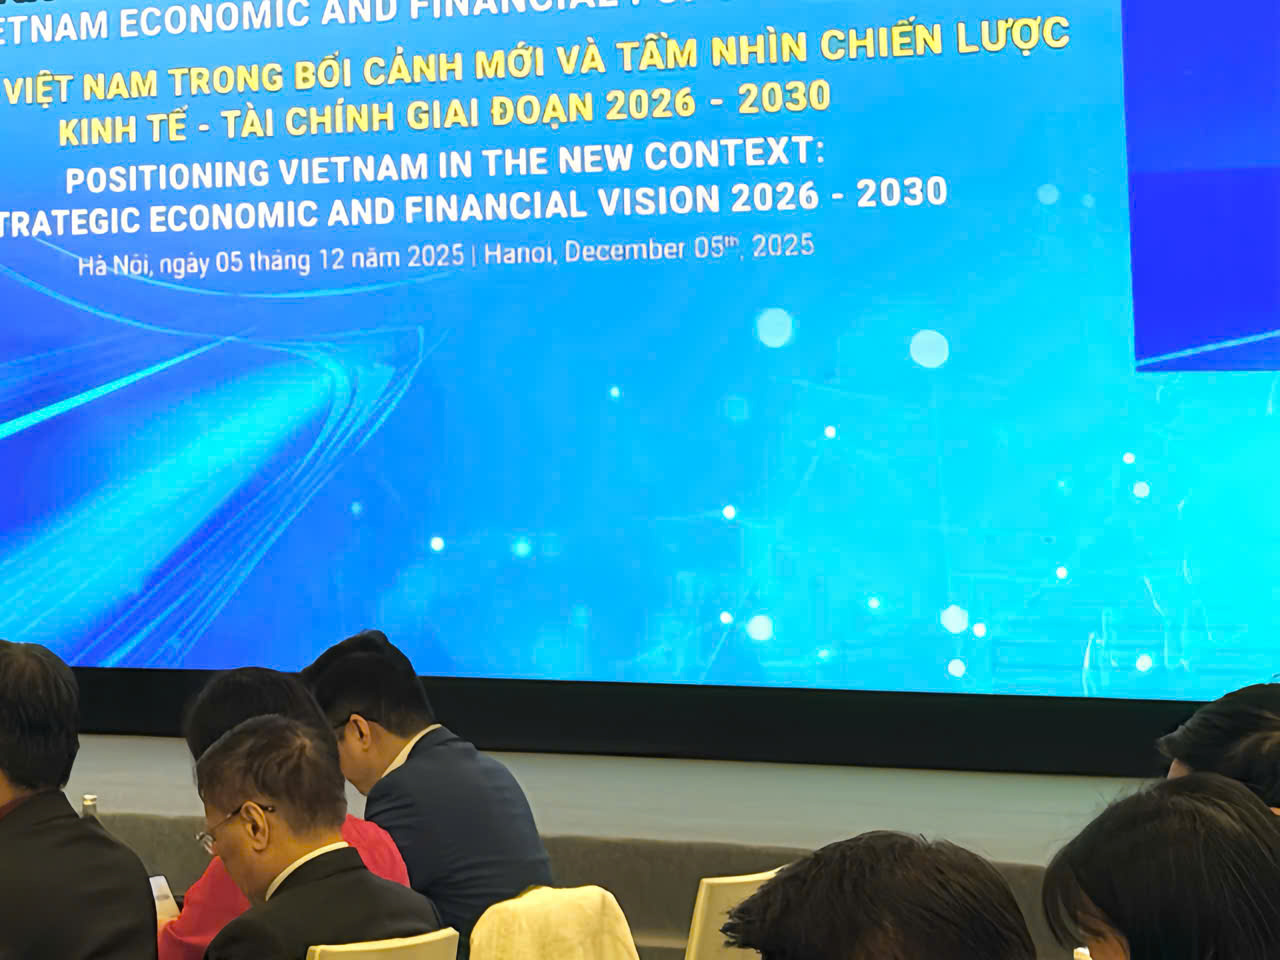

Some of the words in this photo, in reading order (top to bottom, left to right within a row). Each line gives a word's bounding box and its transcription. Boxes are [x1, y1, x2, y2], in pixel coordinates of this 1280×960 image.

[3, 70, 74, 109] VIỆT
[82, 69, 158, 101] NAM
[168, 63, 283, 97] TRONG
[295, 50, 351, 90] BỐI
[363, 46, 463, 87] CẢNH
[475, 41, 544, 79] MỚI
[556, 36, 606, 75] VÀ
[615, 32, 697, 72] TẦM
[711, 25, 807, 67] NHÌN
[820, 16, 943, 61] CHIẾN
[957, 15, 1070, 57] LƯỢC
[59, 115, 137, 147] KINH
[146, 104, 188, 142] TẾ
[221, 101, 274, 139] TÀI
[285, 97, 394, 136] CHÍNH
[406, 98, 478, 130] GIAI
[490, 92, 593, 130] ĐOẠN
[605, 86, 696, 121] 2026
[737, 79, 831, 115] 2030
[65, 159, 269, 195] POSITIONING
[278, 152, 428, 186] VIETNAM
[439, 150, 472, 179] IN
[482, 147, 548, 177] THE
[558, 143, 634, 175] NEW
[644, 135, 825, 171] CONTEXT:
[150, 200, 318, 235] ECONOMIC
[327, 196, 395, 227] AND
[405, 190, 588, 224] FINANCIAL
[598, 185, 719, 217] VISION
[731, 181, 819, 213] 2026
[856, 175, 948, 208] 2030
[78, 254, 107, 277] Hà
[160, 251, 210, 279] ngày
[216, 251, 243, 273] 05
[249, 249, 310, 277] tháng
[320, 248, 344, 270] 12
[351, 247, 400, 268] năm
[408, 243, 464, 267] 2025
[565, 238, 684, 262] December
[752, 233, 815, 258] 2025
